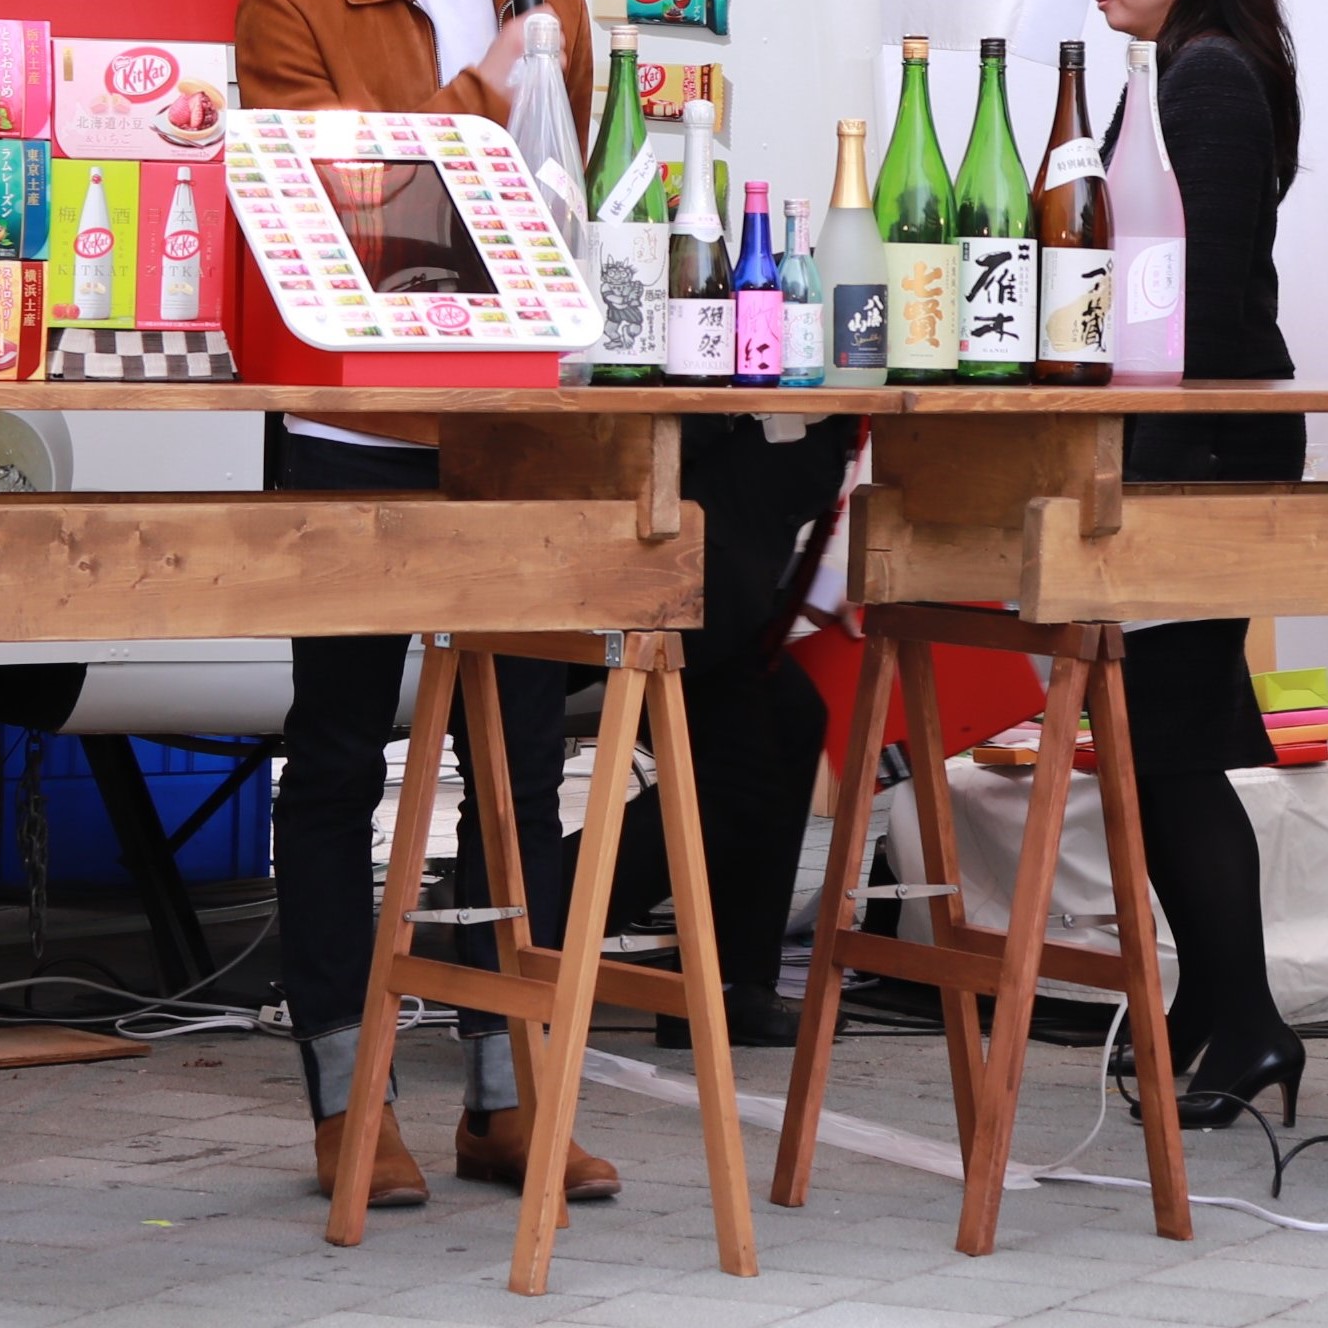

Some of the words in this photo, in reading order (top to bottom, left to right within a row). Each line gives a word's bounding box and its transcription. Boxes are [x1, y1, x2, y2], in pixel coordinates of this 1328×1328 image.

[0, 27, 14, 98] とちおとめ
[26, 30, 41, 86] 栃木土産
[122, 56, 166, 92] KitKat
[76, 116, 145, 131] 北海道小豆
[0, 147, 14, 218] ラムレーズン
[26, 149, 41, 207] 東京土産
[2, 267, 15, 331] ストロベリー
[23, 269, 39, 328] 横浜土産
[965, 251, 1020, 342] 雁木
